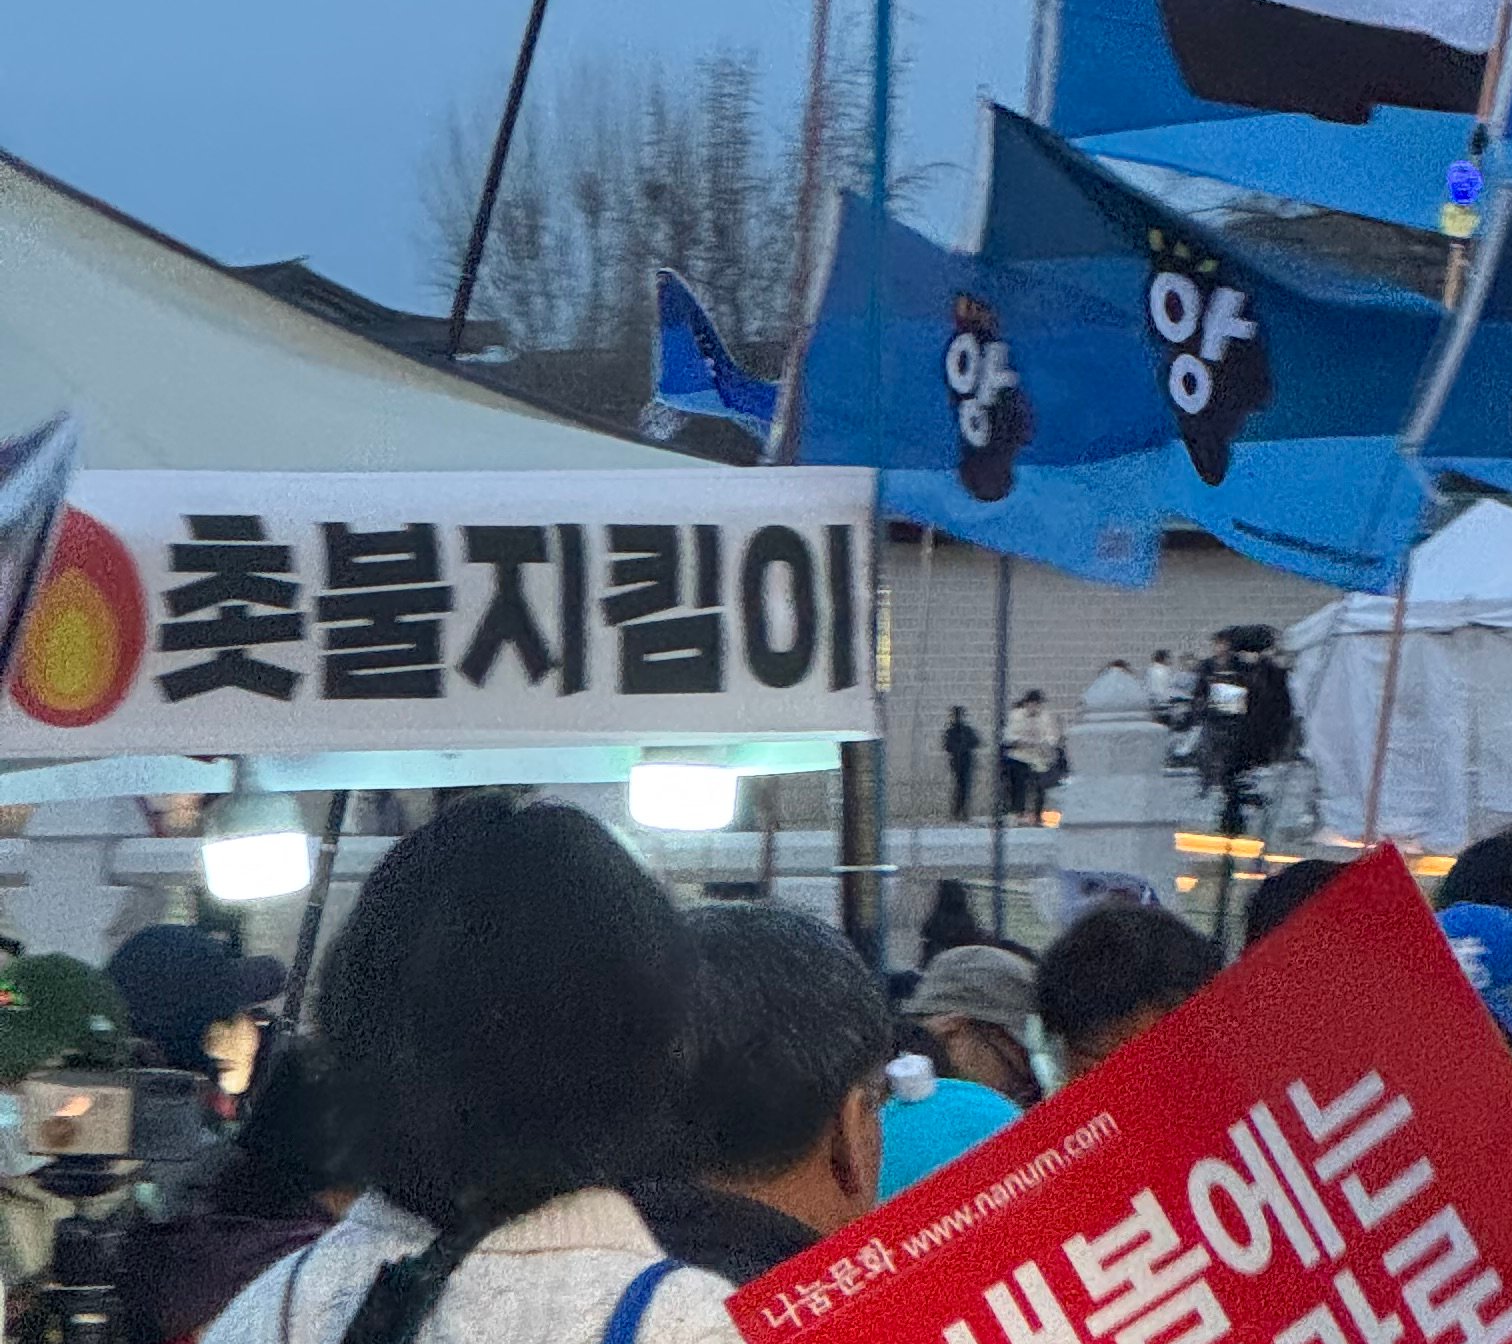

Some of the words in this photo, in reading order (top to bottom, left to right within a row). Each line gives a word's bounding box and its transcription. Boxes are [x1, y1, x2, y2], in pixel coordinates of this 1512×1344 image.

[943, 330, 1021, 449] 앙
[1147, 270, 1259, 415] 앙
[154, 512, 856, 703] 촛불지킴이
[761, 1238, 897, 1329] 나눔문화
[902, 1111, 1120, 1258] www.nanum.com
